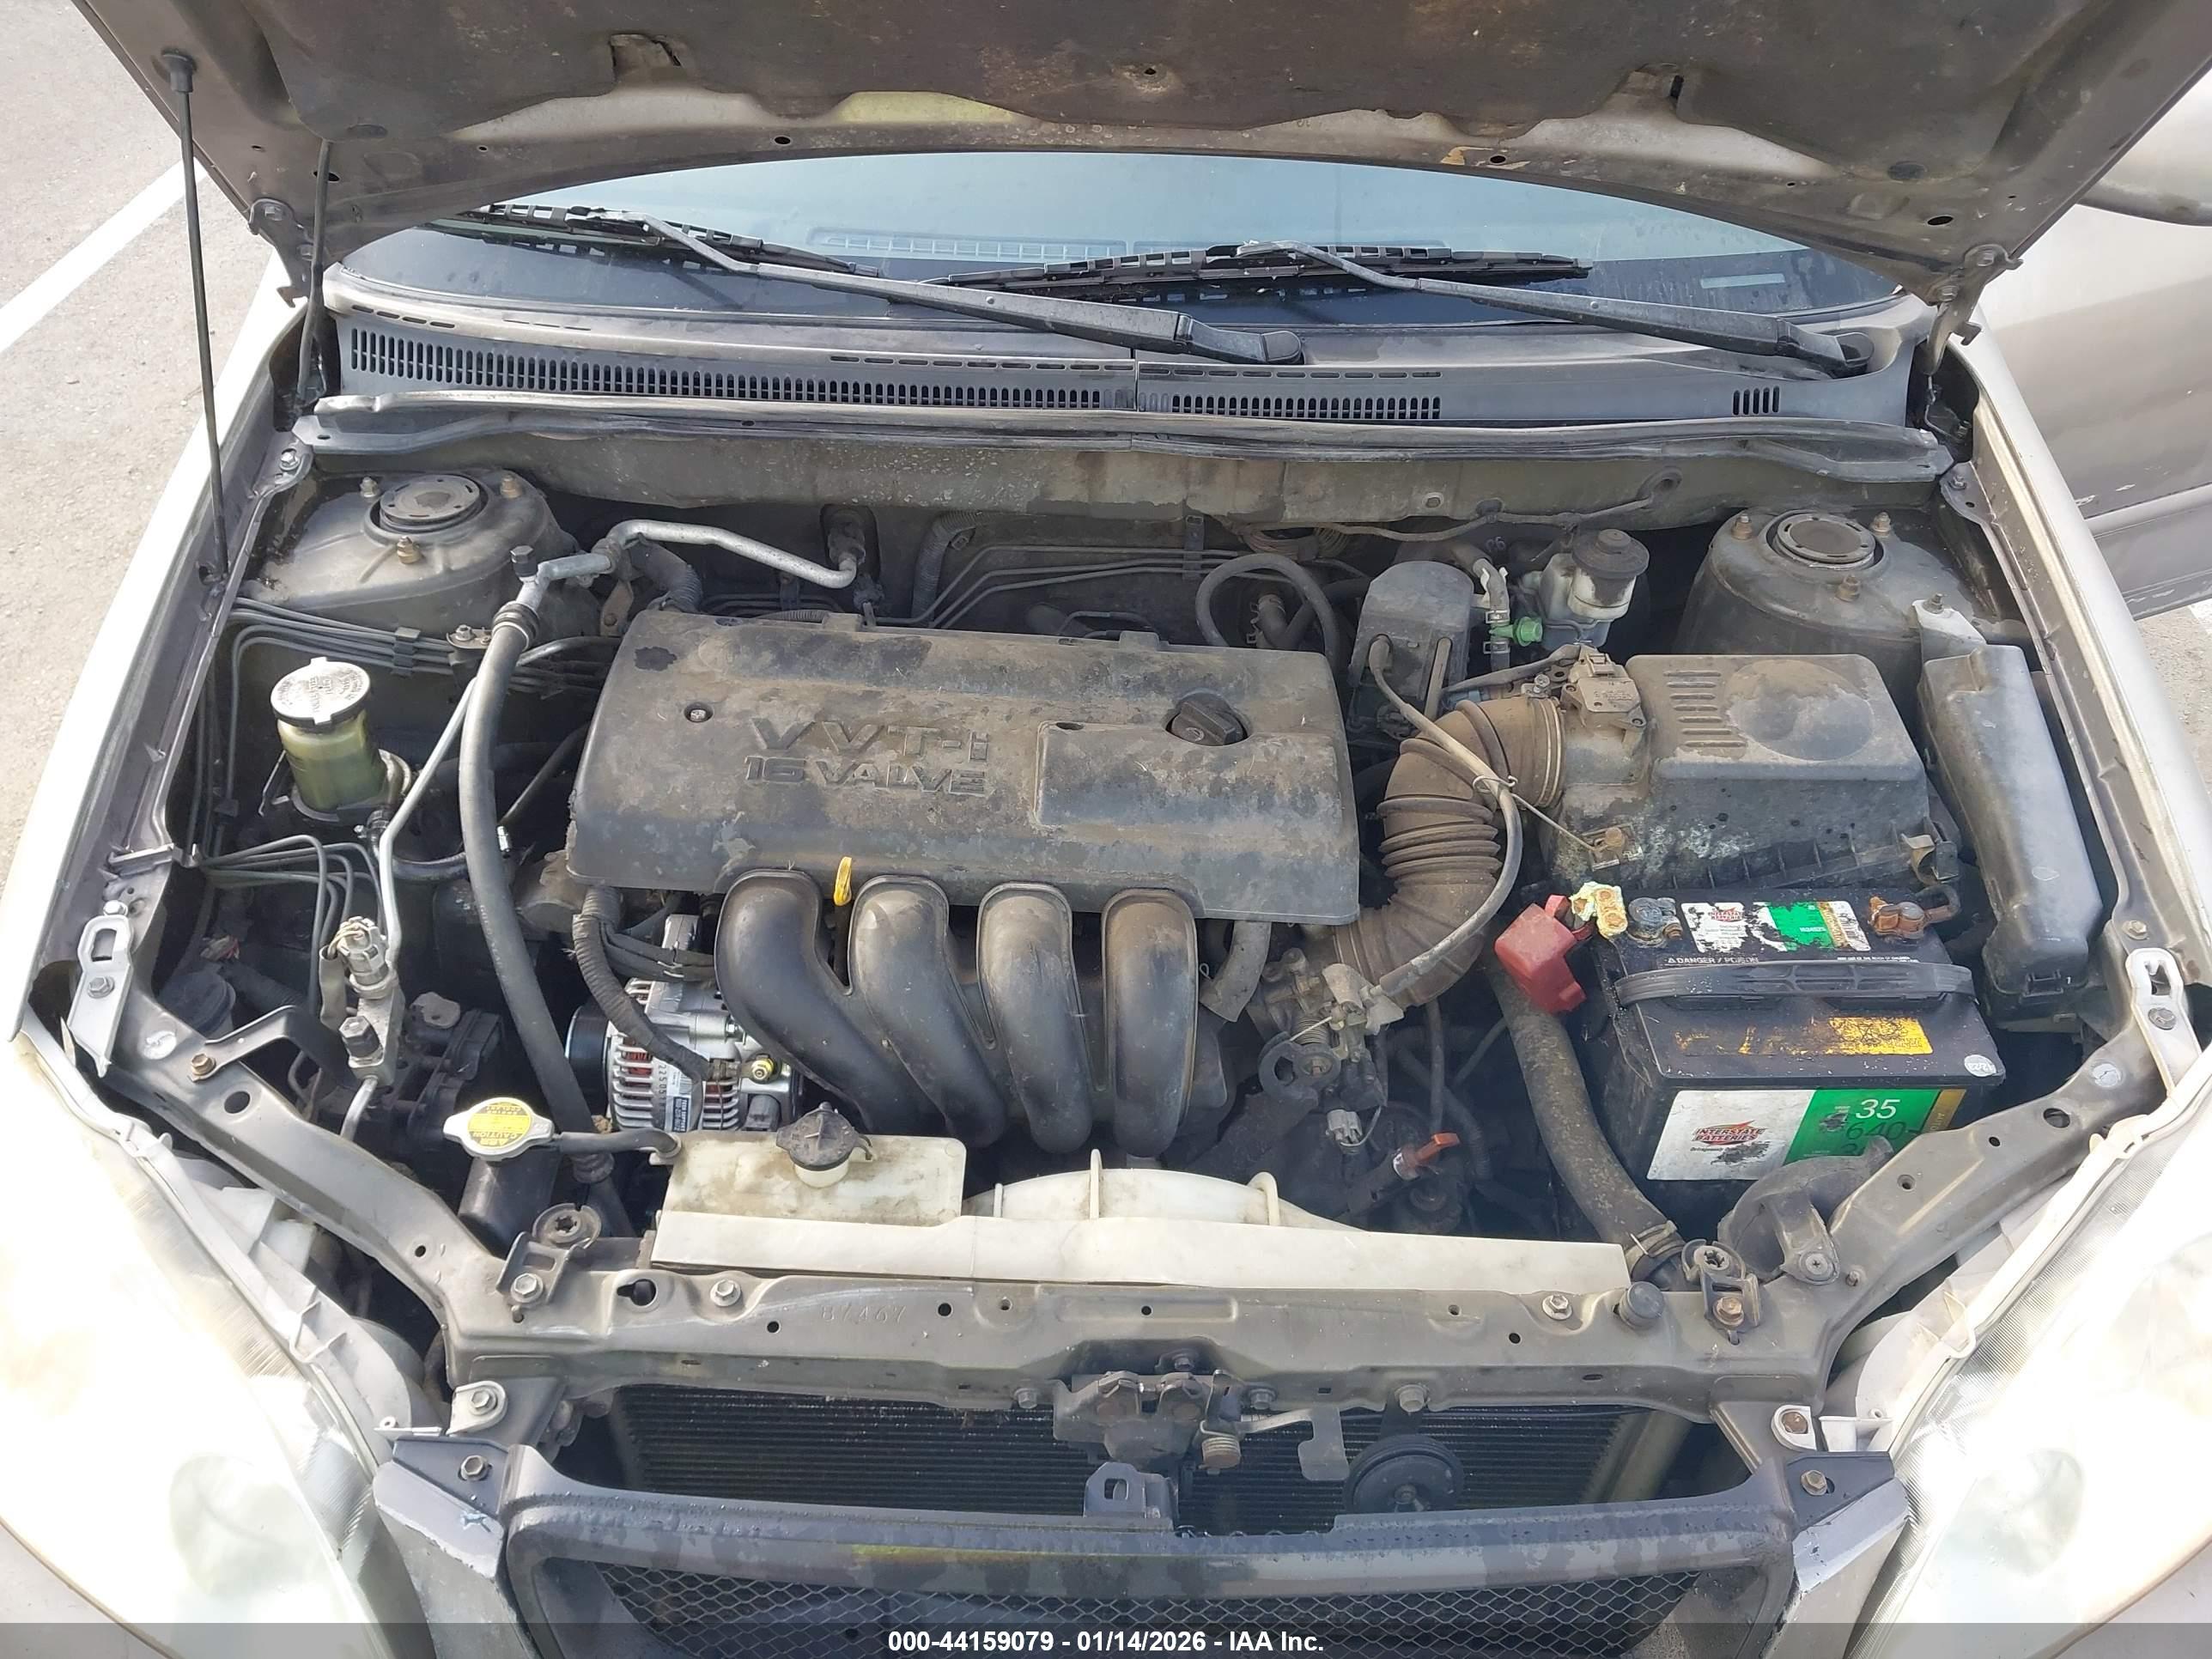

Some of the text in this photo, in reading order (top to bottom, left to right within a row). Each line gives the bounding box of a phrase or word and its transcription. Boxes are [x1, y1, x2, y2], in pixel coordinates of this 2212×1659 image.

[744, 755, 990, 797] 16 VALVE
[1856, 1098, 1900, 1119] 35
